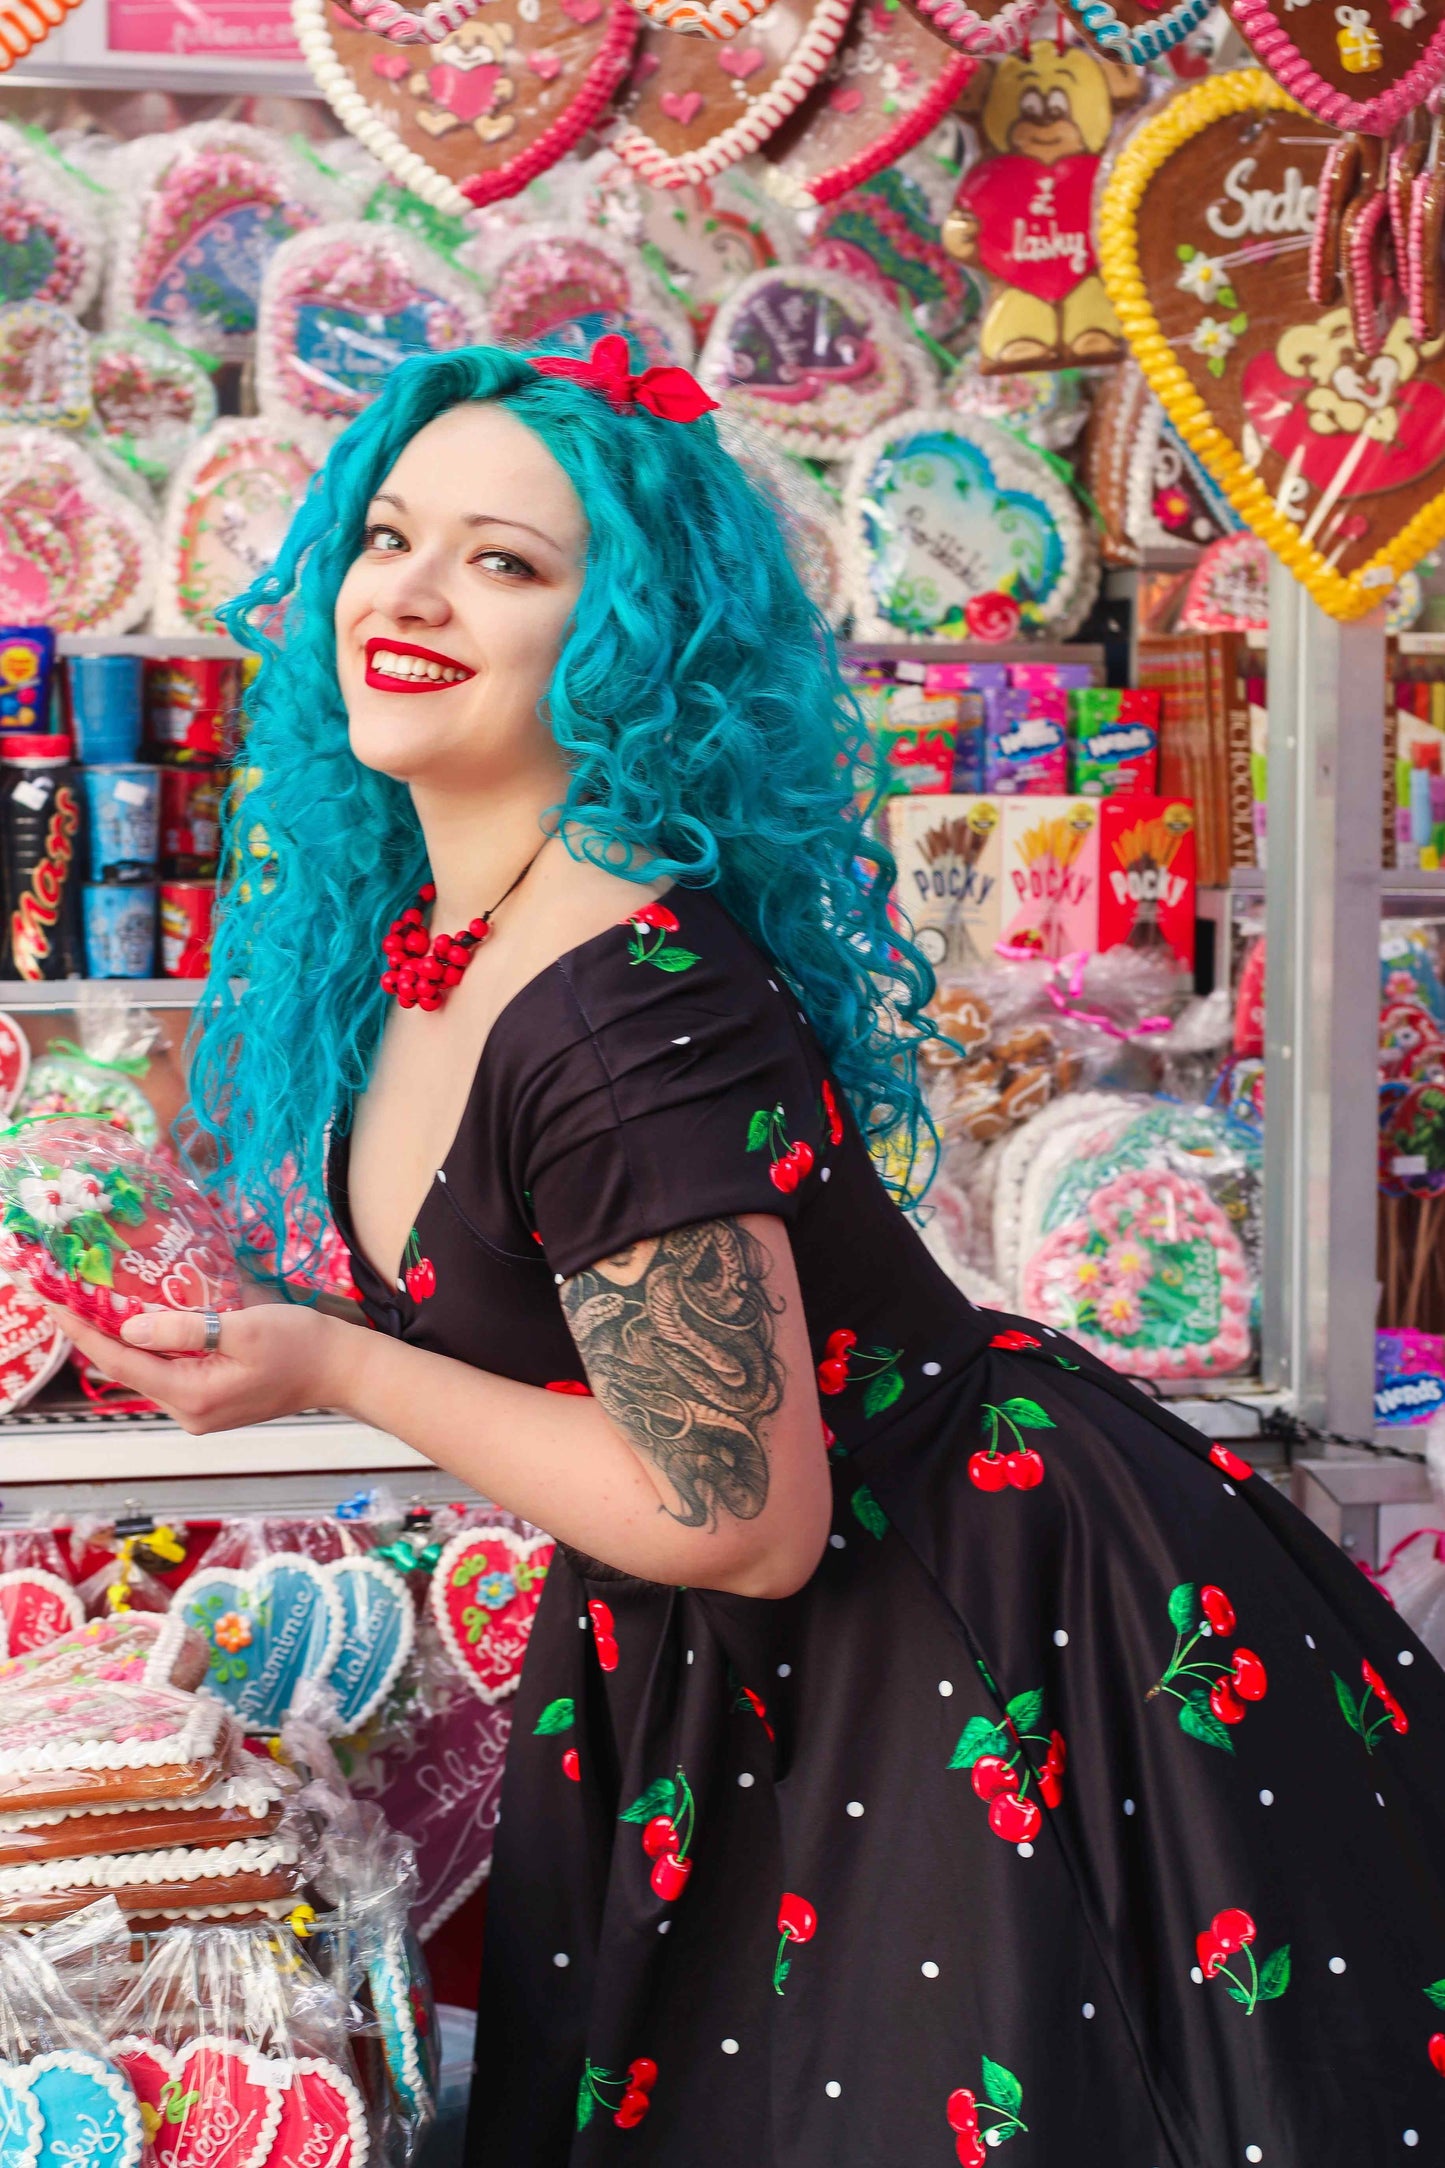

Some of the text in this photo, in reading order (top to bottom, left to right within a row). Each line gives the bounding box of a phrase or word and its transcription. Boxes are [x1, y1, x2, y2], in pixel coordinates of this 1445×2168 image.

[10, 785, 81, 982] Mars
[912, 865, 995, 905] POCKY
[1010, 865, 1092, 906] POCKY
[1108, 864, 1189, 907] POCKY
